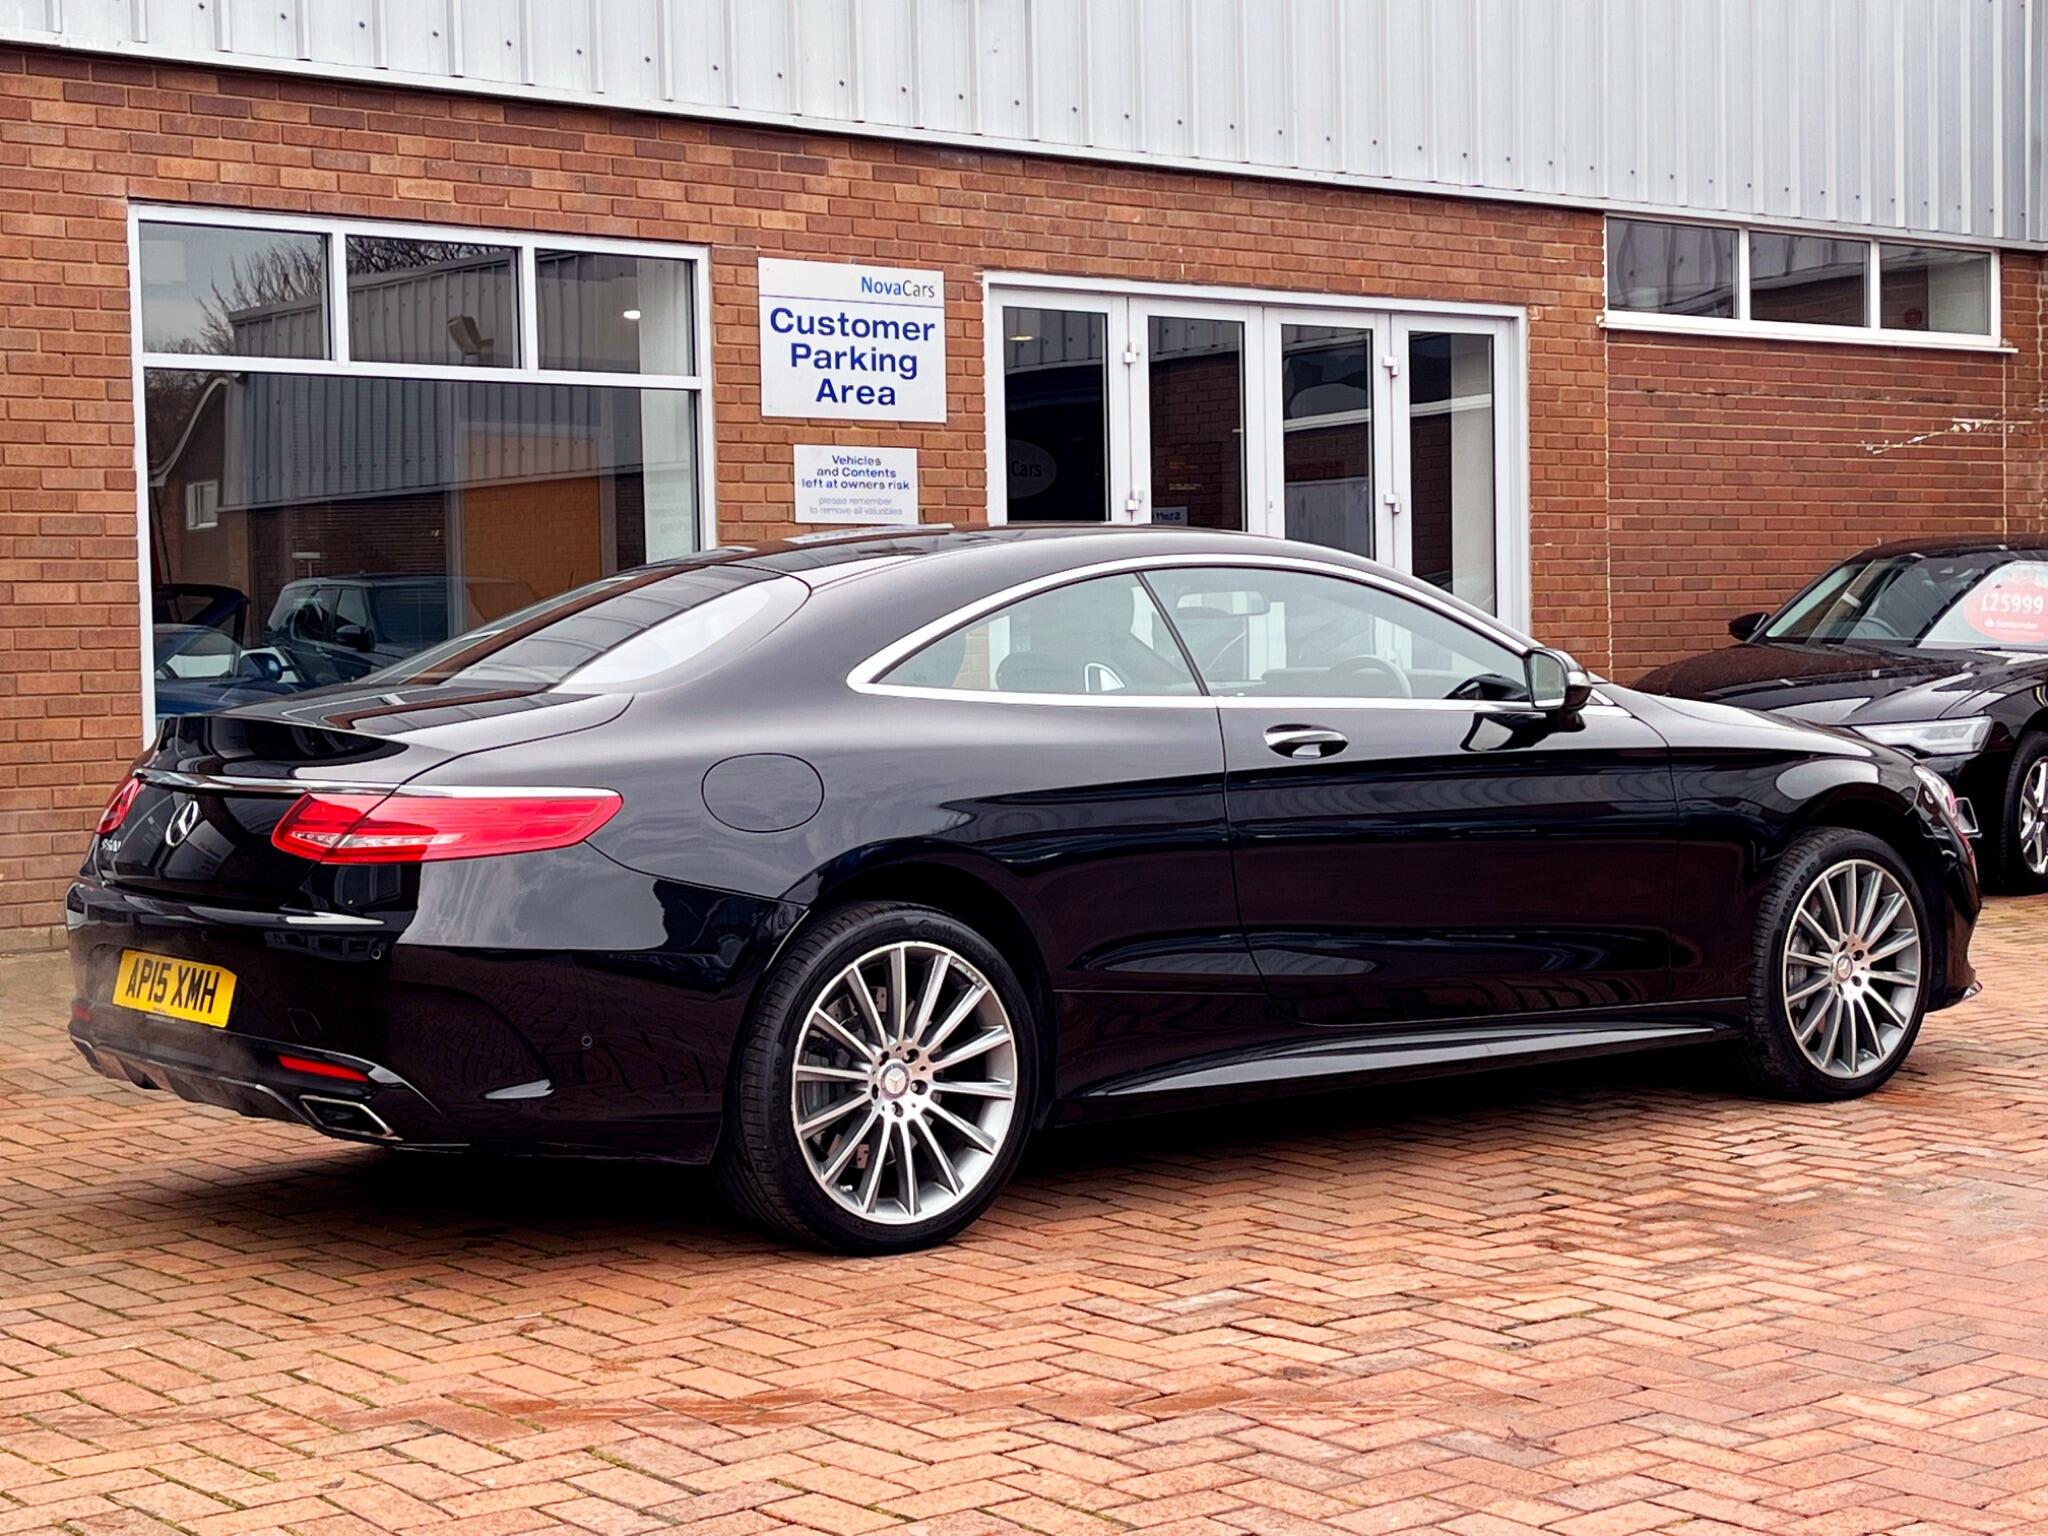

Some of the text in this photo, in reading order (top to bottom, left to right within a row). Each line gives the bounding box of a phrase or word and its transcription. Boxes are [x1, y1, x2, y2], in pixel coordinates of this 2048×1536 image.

[861, 276, 935, 298] NovaCars
[770, 307, 936, 341] Customer
[791, 342, 918, 380] Parking
[815, 378, 896, 406] Area
[831, 455, 882, 466] Vehicles
[1011, 460, 1042, 477] Cars
[816, 467, 897, 478] and Contents
[801, 478, 910, 490] left at owners risk
[809, 506, 818, 514] to
[1980, 592, 2044, 615] £25999
[125, 957, 220, 1014] AP15 XMH
